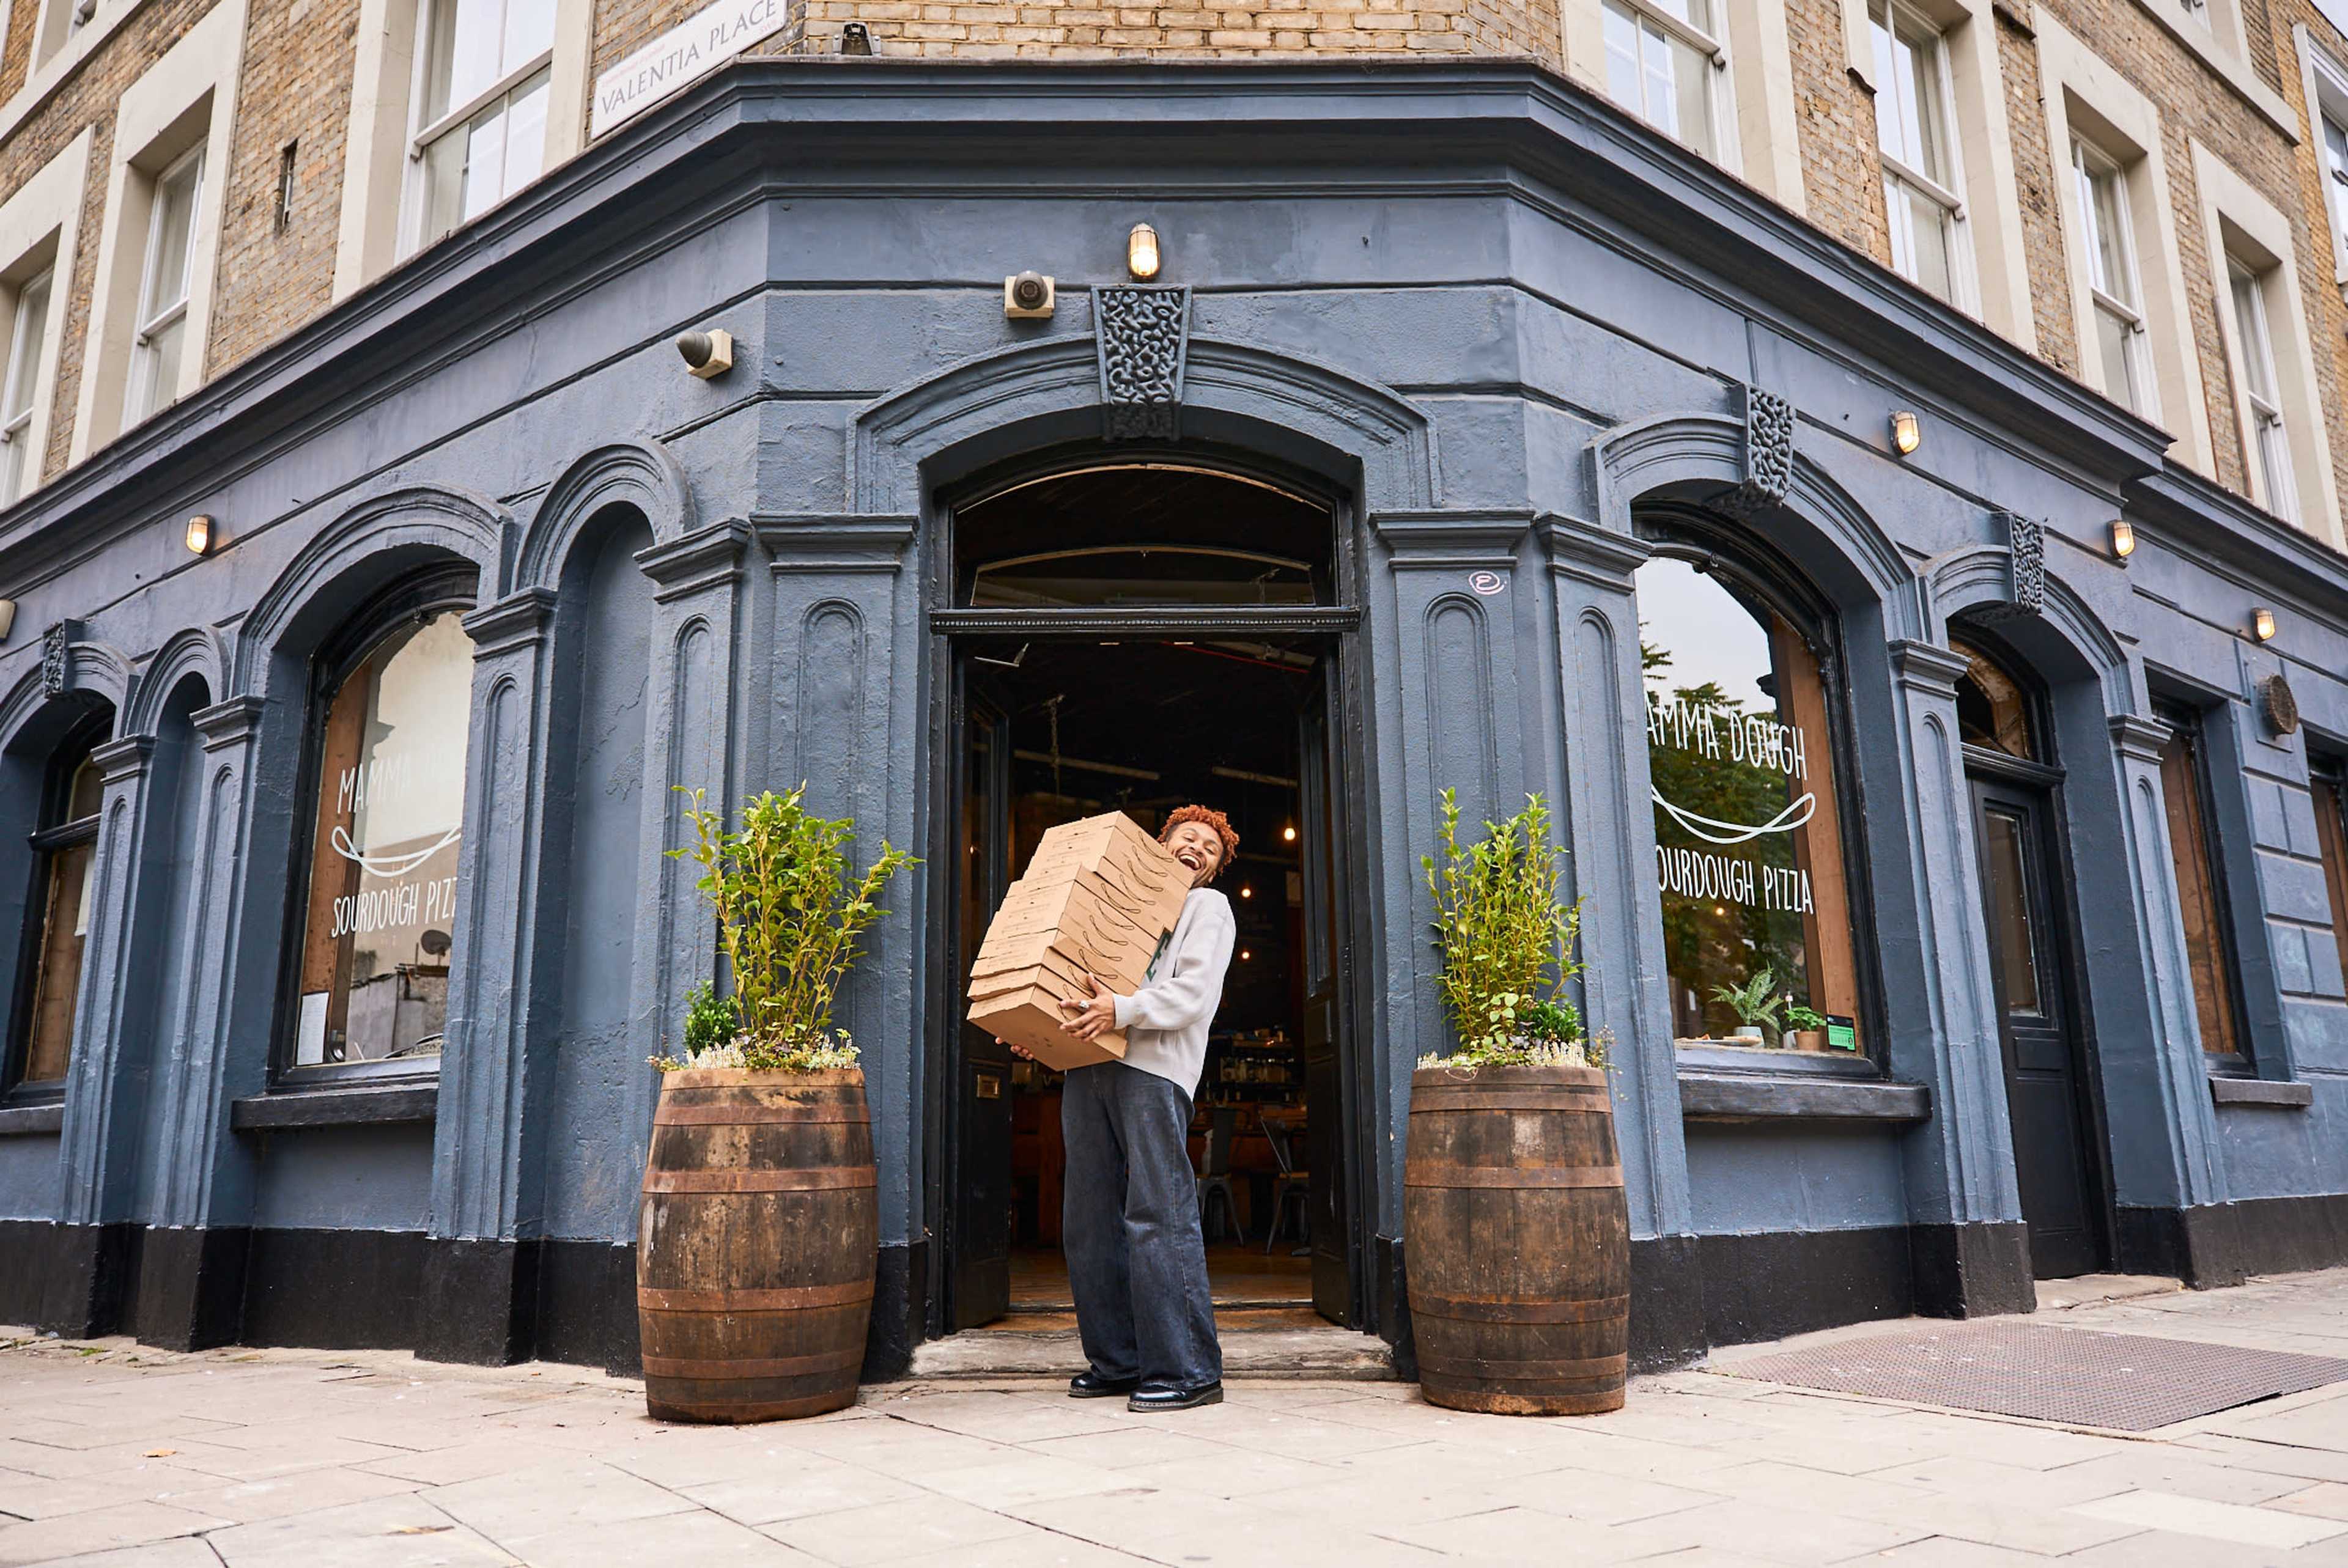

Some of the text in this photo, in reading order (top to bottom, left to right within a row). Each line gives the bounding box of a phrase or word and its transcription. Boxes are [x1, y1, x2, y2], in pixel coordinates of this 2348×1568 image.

[602, 42, 700, 114] VALENTIA
[709, 0, 776, 52] PLACE
[1729, 710, 1807, 781] DOUGH
[331, 883, 420, 938] SOURDOUGH
[1763, 865, 1814, 915] PIZZA
